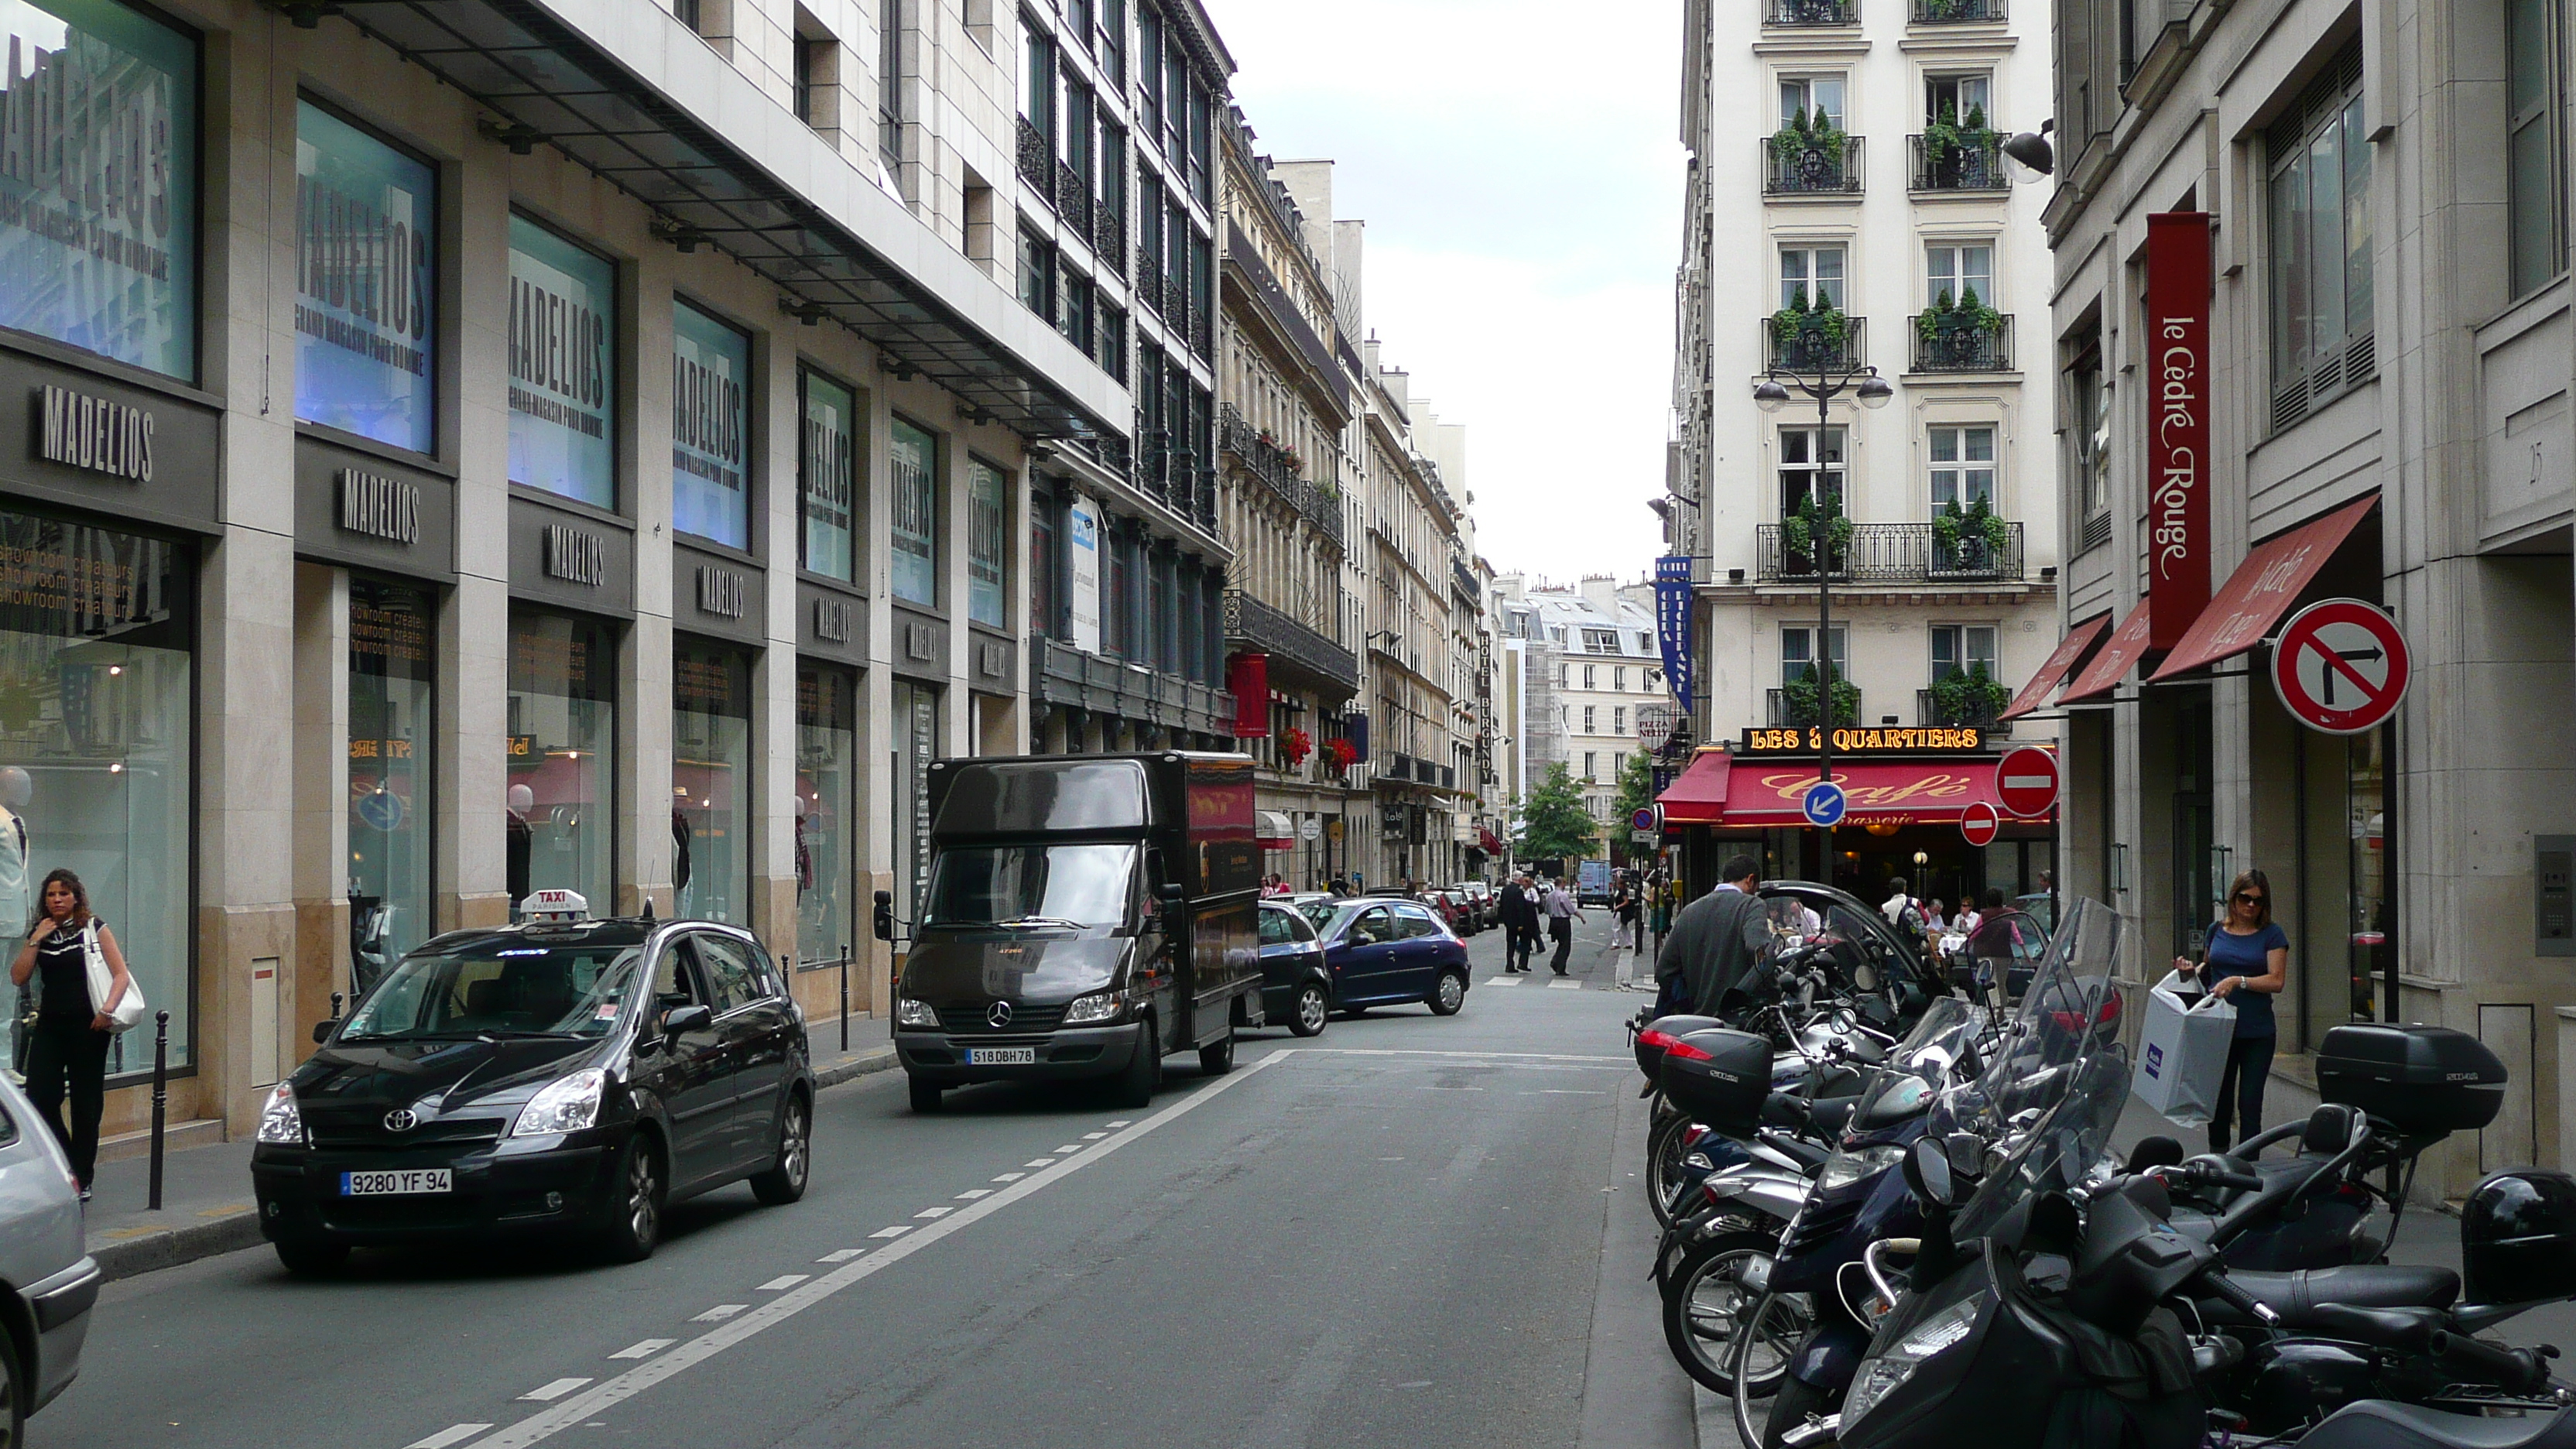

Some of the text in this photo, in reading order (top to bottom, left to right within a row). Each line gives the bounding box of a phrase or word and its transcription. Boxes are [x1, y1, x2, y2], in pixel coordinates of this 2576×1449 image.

[44, 385, 153, 482] MADELIOS
[2154, 316, 2195, 581] le Cèdre Rouge
[343, 468, 419, 544] MADELIOS
[550, 525, 605, 586] MADELIOS
[701, 566, 744, 619] MADELIOS
[818, 598, 851, 643] MADELIOS
[1481, 635, 1490, 780] HOTEL BURGUNDY
[1750, 730, 1800, 749] LES
[1832, 728, 1979, 752] QUARTIERS
[1761, 773, 1971, 806] Café
[538, 892, 565, 903] TAXI
[974, 1050, 1032, 1062] 518 DBH 78
[352, 1172, 448, 1194] 9280 YF 94
